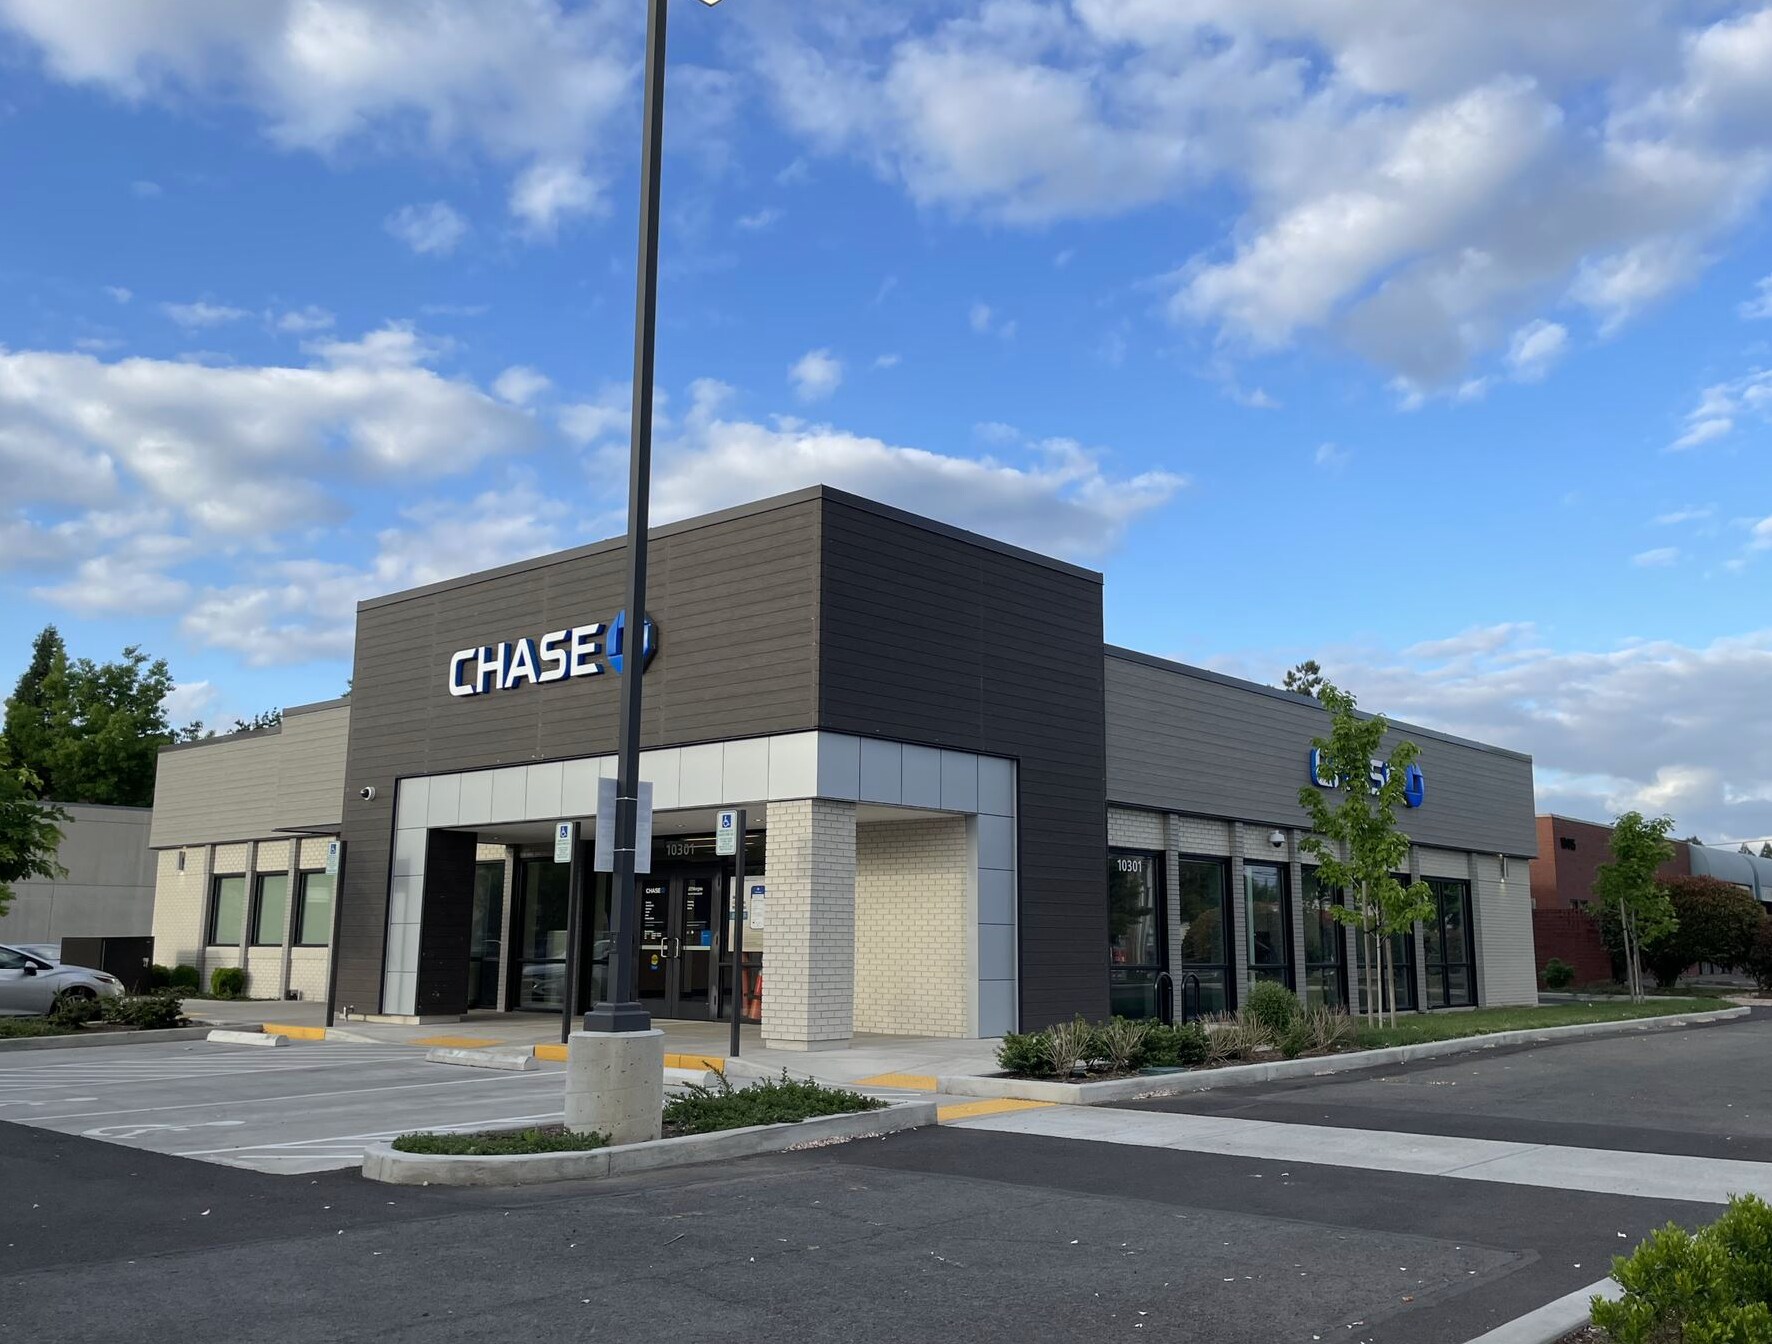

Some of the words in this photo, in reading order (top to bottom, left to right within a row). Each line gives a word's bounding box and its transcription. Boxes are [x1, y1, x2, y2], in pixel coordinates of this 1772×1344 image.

[449, 623, 602, 697] CHASE
[666, 843, 695, 856] 10301
[1117, 859, 1143, 873] 10301
